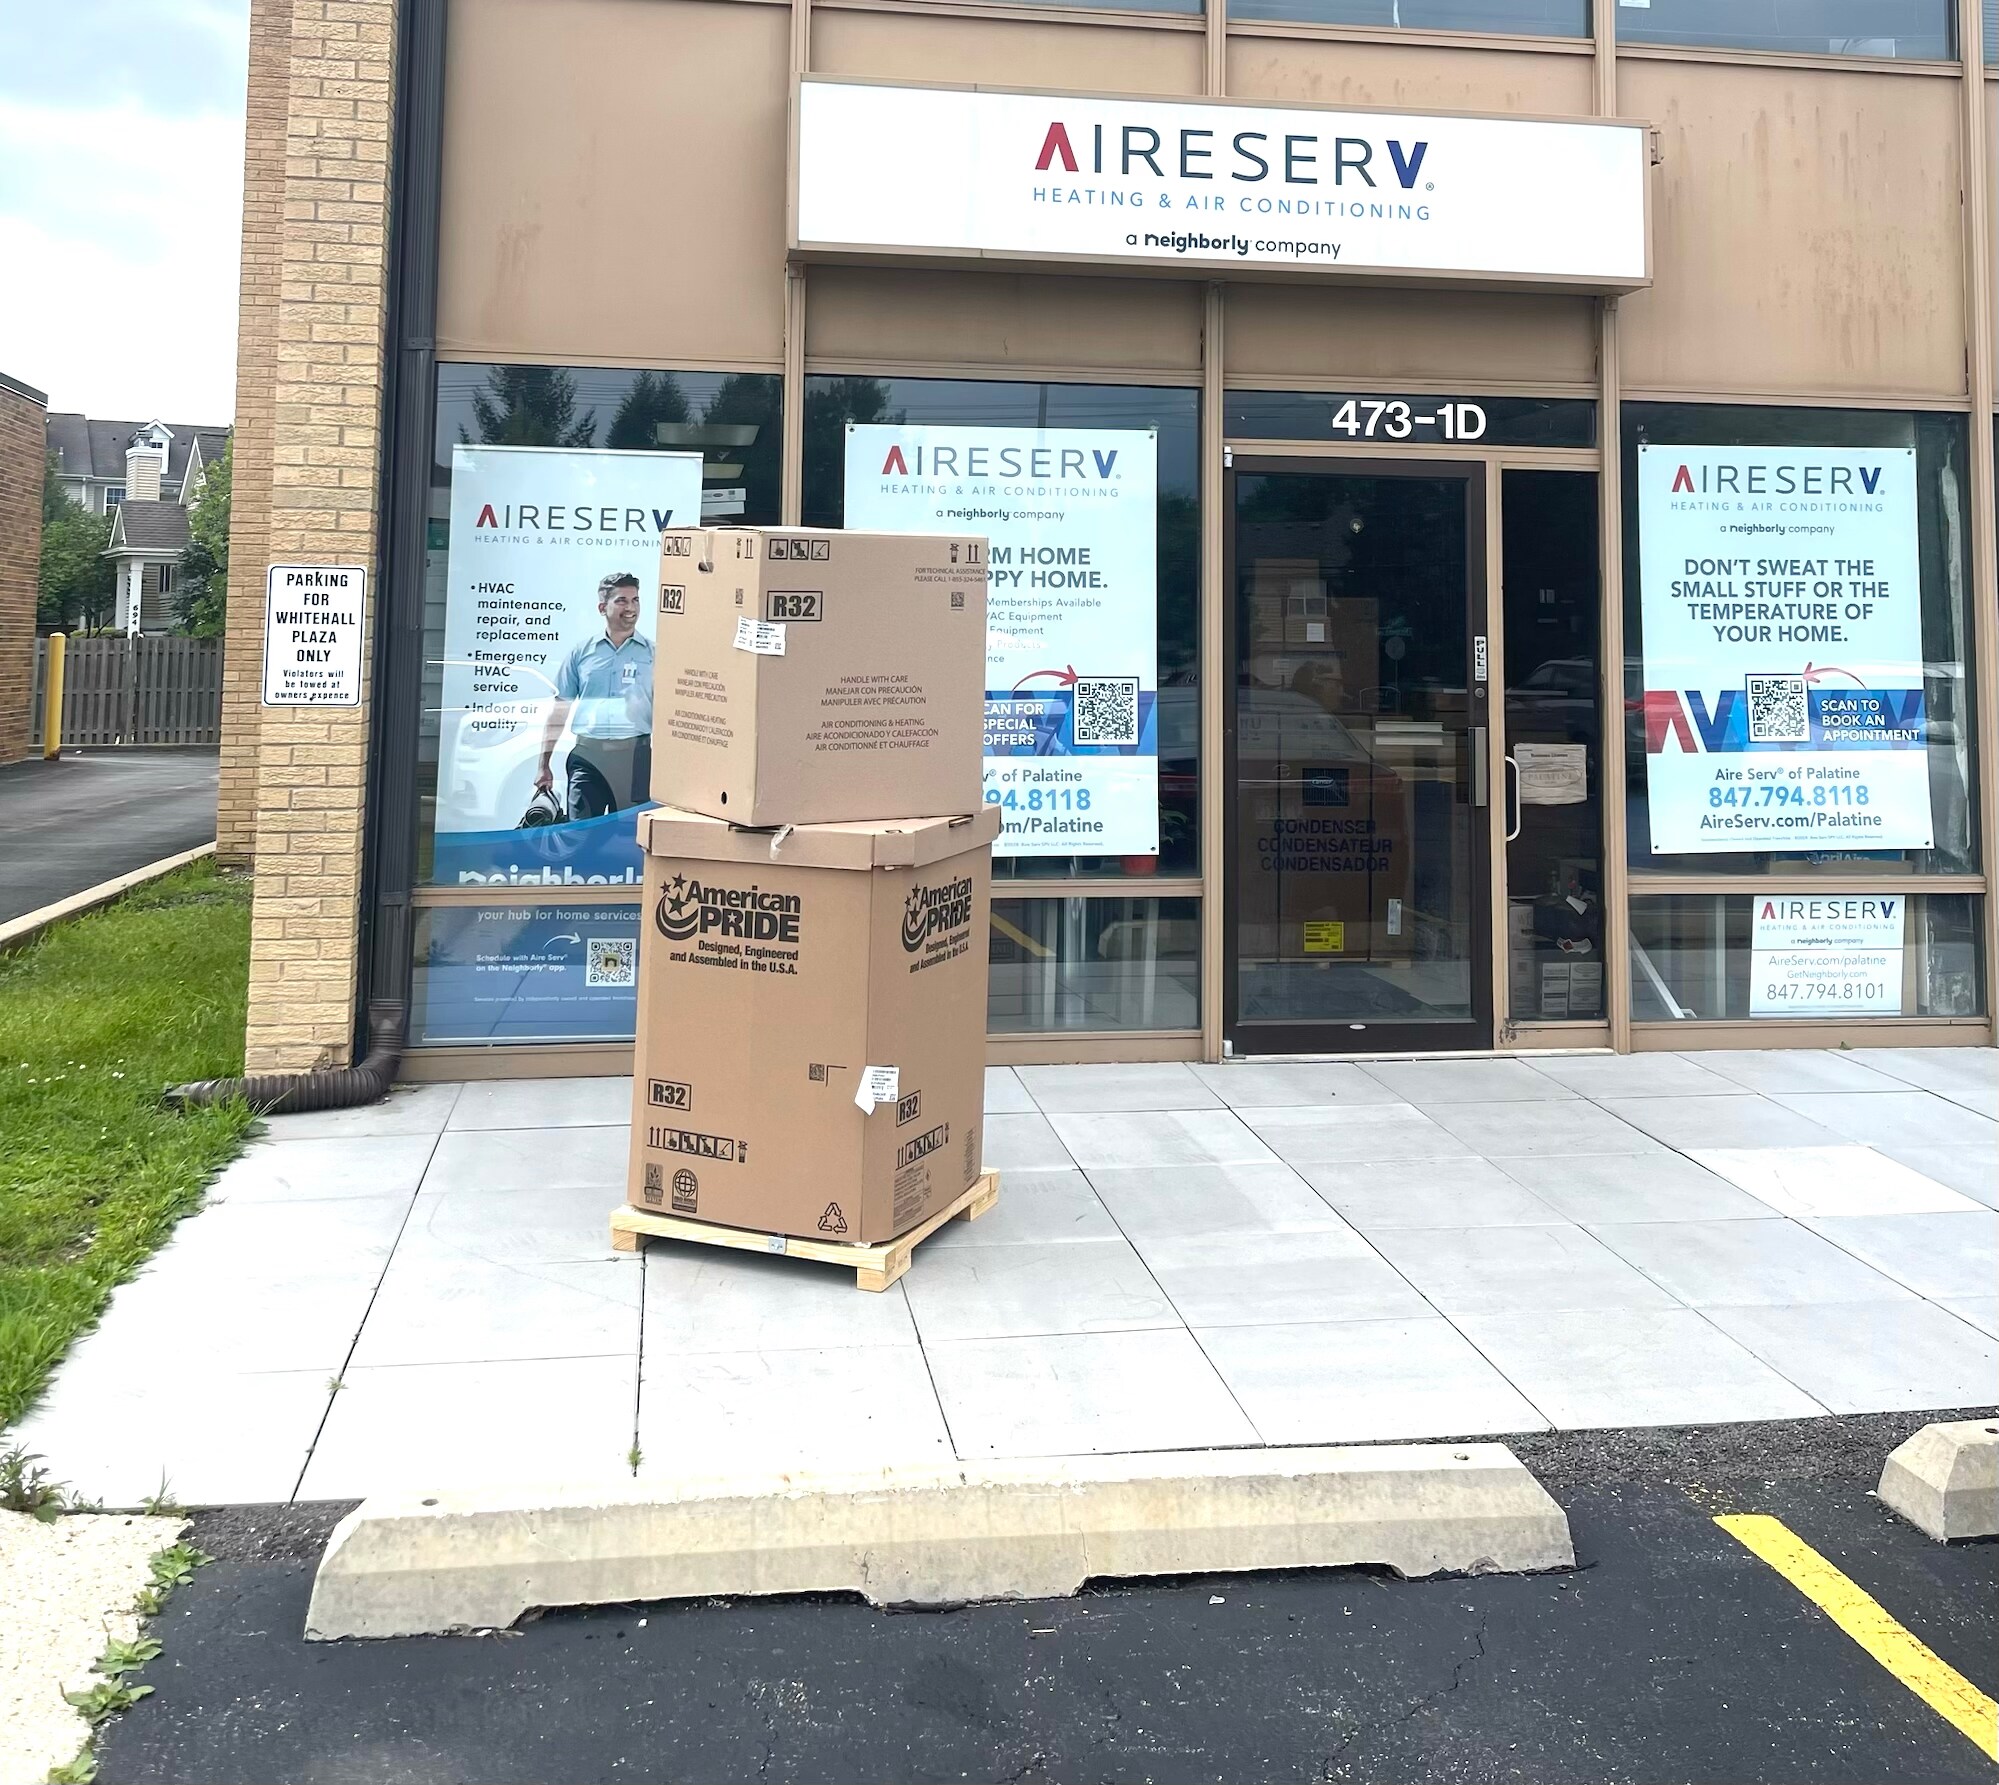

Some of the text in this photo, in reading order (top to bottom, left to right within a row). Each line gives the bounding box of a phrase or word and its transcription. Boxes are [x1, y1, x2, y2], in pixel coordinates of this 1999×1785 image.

[1033, 187, 1430, 221] HEATING & AIR CONDITIONING
[1125, 231, 1341, 259] a neighborly company
[1332, 400, 1486, 441] 473-1D
[880, 484, 1119, 498] HEATING & AIR CONDITIONING
[1671, 502, 1884, 512] HEATING & AIR CONDITIONING
[936, 509, 1065, 522] a neighborly company
[1720, 523, 1835, 535] a neighborly company
[474, 535, 662, 547] HEATING & AIR CONDITIONIN
[1020, 547, 1091, 565] HOME
[1684, 558, 1875, 576] DON'T SWEAT THE
[286, 572, 348, 587] PARKING
[1031, 571, 1108, 589] HOME.
[478, 583, 515, 594] HVAC
[1670, 581, 1890, 598] SMALL STUFF OR THE
[303, 593, 329, 606] FOR
[662, 587, 682, 609] R32
[987, 598, 1101, 609] Memberships Available
[477, 600, 566, 612] maintenance,
[773, 595, 815, 617] R32
[1687, 603, 1874, 620] TEMPERATURE OF
[276, 611, 356, 625] WHITEHALL
[476, 615, 551, 628] repair, and
[1009, 612, 1063, 623] Equipment
[292, 630, 337, 643] PLAZA
[476, 630, 559, 642] replacement
[1713, 626, 1848, 642] YOUR HOME.
[296, 649, 331, 662] ONLY
[475, 651, 547, 664] Emergency
[1476, 640, 1485, 667] PULL
[283, 669, 344, 678] Violators will
[474, 666, 511, 677] HVAC
[285, 680, 295, 688] be
[300, 680, 327, 688] towed
[840, 674, 909, 684] HANDLE WITH CARE
[473, 682, 519, 693] service
[825, 685, 922, 695] MANEJAR CON PRECAUCIÓN
[275, 691, 349, 700] owners expence
[821, 698, 862, 706] MANIPULER
[520, 704, 538, 713] air
[984, 703, 1044, 715] CAN FOR
[1820, 699, 1880, 712] SCAN TO
[821, 718, 925, 729] AIR CONDITIONING HEATING
[983, 718, 1037, 730] SPECIAL
[1822, 714, 1885, 727] BOOK AN
[806, 728, 939, 741] AIRE ACONDICIONADO Y CALEFACCIÓN
[983, 733, 1035, 746] OFFERS
[1823, 729, 1920, 742] APPOINTMENT
[815, 743, 828, 751] AIR
[879, 741, 888, 749] ET
[888, 740, 930, 749] CHAUFFAGE
[1002, 769, 1017, 782] of
[1022, 769, 1083, 782] Palatine
[1715, 768, 1743, 780] Aire
[1788, 766, 1802, 780] of
[1806, 767, 1860, 779] Palatine
[986, 788, 1091, 811] 94.8118
[1709, 784, 1869, 808] 847.794.8118
[1274, 819, 1376, 834] CONDENSER
[1700, 812, 1882, 830] AireServ.com/Palatine
[1257, 838, 1392, 853] CONDENSATEUR
[1261, 857, 1389, 871] CONDENSADOR
[685, 880, 800, 913] American
[920, 876, 972, 910] American
[477, 909, 641, 923] your hub for home services
[926, 895, 972, 937] PRIDE
[700, 905, 800, 943] PRIDE
[698, 940, 799, 960] Designed, Engineered
[476, 954, 511, 962] Schedule
[530, 953, 546, 961] Aire
[670, 951, 798, 975] and Assembled in the U.S.A.
[1769, 954, 1887, 968] AireServ.com/palatine
[488, 964, 499, 972] the
[549, 965, 567, 974] app.
[1787, 970, 1868, 981] GetNeighborly.com
[1767, 982, 1885, 1001] 847.794.8101
[652, 1083, 686, 1107] R32
[899, 1095, 919, 1122] R32
